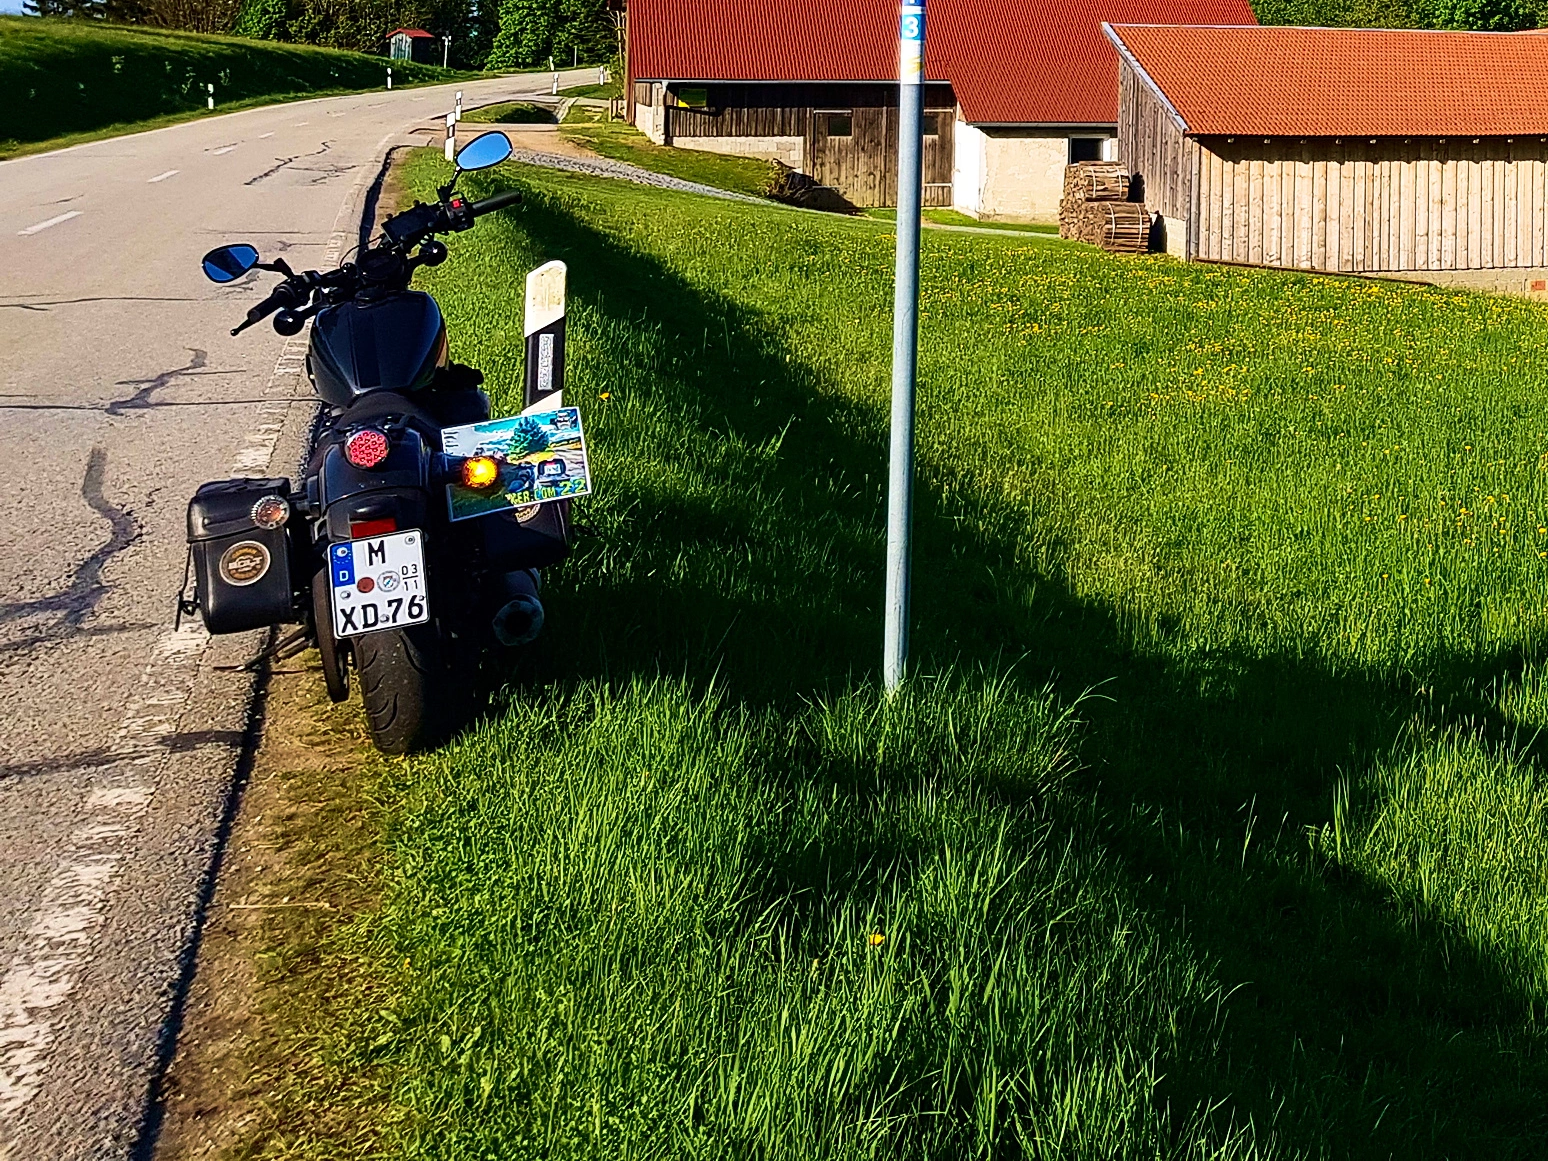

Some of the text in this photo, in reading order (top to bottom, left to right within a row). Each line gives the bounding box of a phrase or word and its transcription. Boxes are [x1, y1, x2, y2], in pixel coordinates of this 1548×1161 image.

[904, 16, 919, 38] 3
[560, 478, 586, 496] 22
[367, 540, 386, 566] M
[340, 570, 349, 581] D
[401, 563, 418, 575] 03
[340, 595, 424, 633] XD 76
